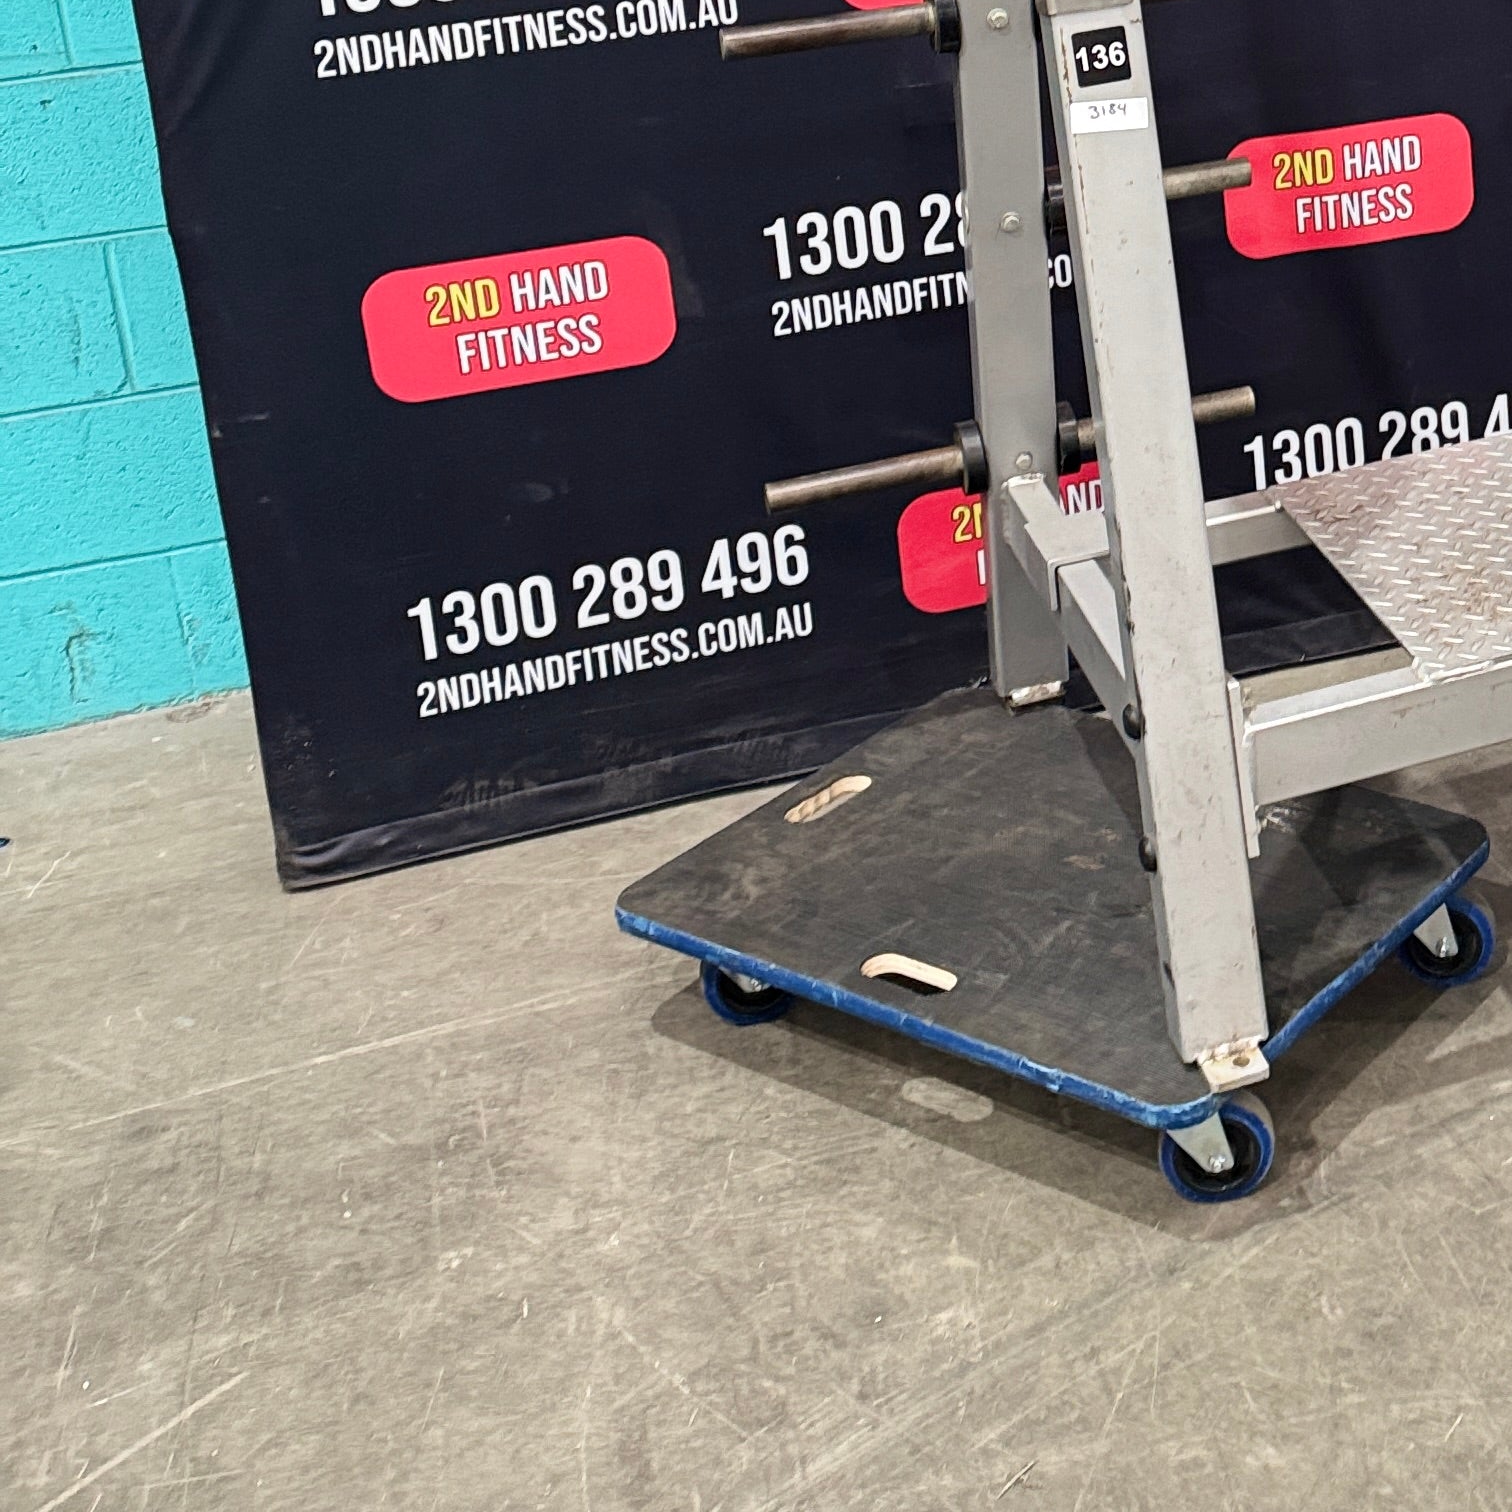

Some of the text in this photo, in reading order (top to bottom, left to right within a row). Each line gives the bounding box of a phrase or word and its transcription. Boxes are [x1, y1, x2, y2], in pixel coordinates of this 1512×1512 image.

[1075, 41, 1126, 72] 136
[1087, 103, 1127, 120] 3184
[1274, 136, 1420, 188] 2ND HAND
[1297, 184, 1412, 232] FITNESS
[763, 201, 904, 279] 1300
[426, 262, 607, 325] 2ND HAND
[457, 315, 601, 373] FITNESS
[1243, 417, 1365, 491] 1300
[408, 525, 808, 660] 1300 289 496
[417, 602, 812, 717] 2NDHANDFITNESS.COM.AU
